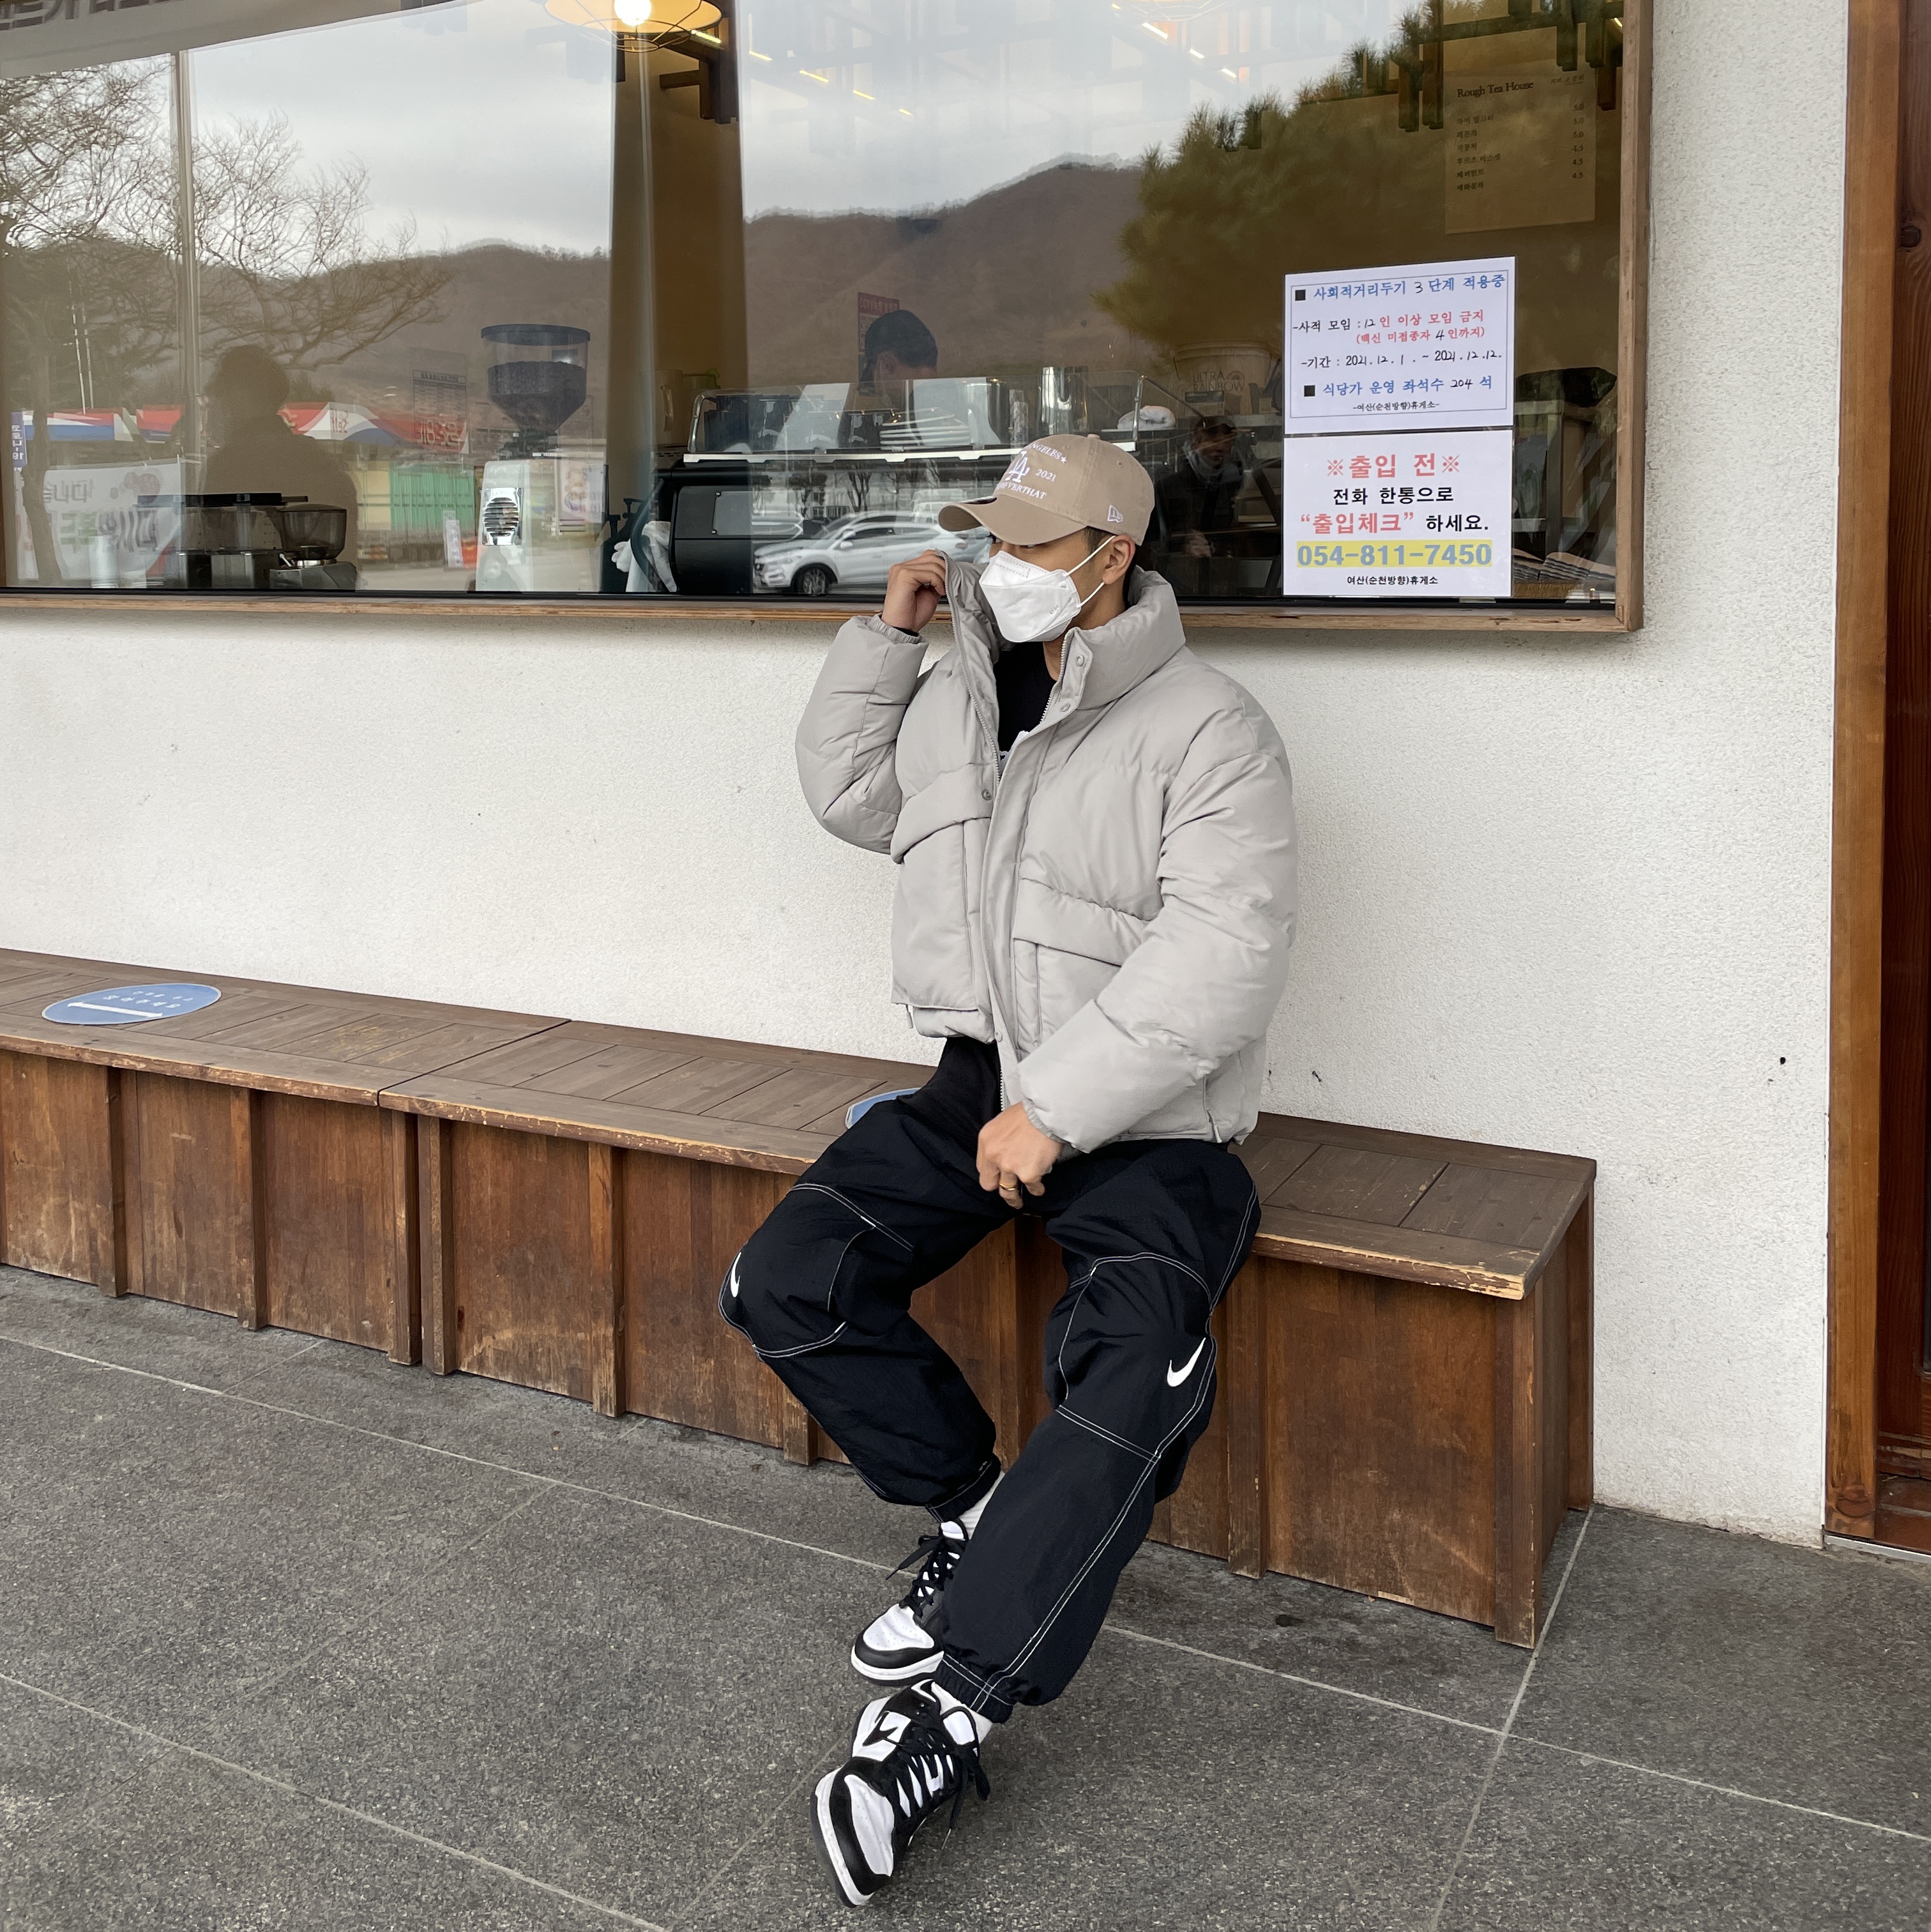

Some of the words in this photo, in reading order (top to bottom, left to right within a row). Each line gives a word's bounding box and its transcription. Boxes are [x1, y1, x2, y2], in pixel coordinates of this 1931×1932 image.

[1457, 85, 1485, 98] Rough
[1487, 84, 1503, 94] Tea
[1506, 81, 1534, 92] House
[1314, 281, 1406, 300] 사회적거리두기
[1414, 281, 1423, 294] 3
[1429, 277, 1455, 292] 단계
[1463, 274, 1505, 290] 적용중
[1328, 317, 1351, 331] 모임
[1380, 315, 1391, 328] 인
[1398, 313, 1422, 326] 이상
[1428, 311, 1452, 324] 모임
[1459, 309, 1484, 323] 금지
[1356, 332, 1381, 345] (백신
[1388, 331, 1431, 343] 미접종자
[1435, 329, 1445, 341] 4
[1448, 326, 1485, 340] 인까지)
[1193, 371, 1225, 383] ULTRA
[1193, 381, 1244, 392] RAINBOW
[1323, 383, 1363, 397] 식당가
[1370, 381, 1395, 394] 운영
[1403, 378, 1444, 393] 좌석수
[1450, 378, 1473, 389] 204
[1480, 376, 1492, 390] 석
[1035, 469, 1057, 482] 2021
[1333, 487, 1368, 505] 전화
[1379, 487, 1454, 505] 한통으로
[1426, 514, 1489, 532] 하세요.
[1297, 543, 1492, 566] 054-811-7450
[1347, 575, 1439, 586] 여산(순천방향)휴게소
